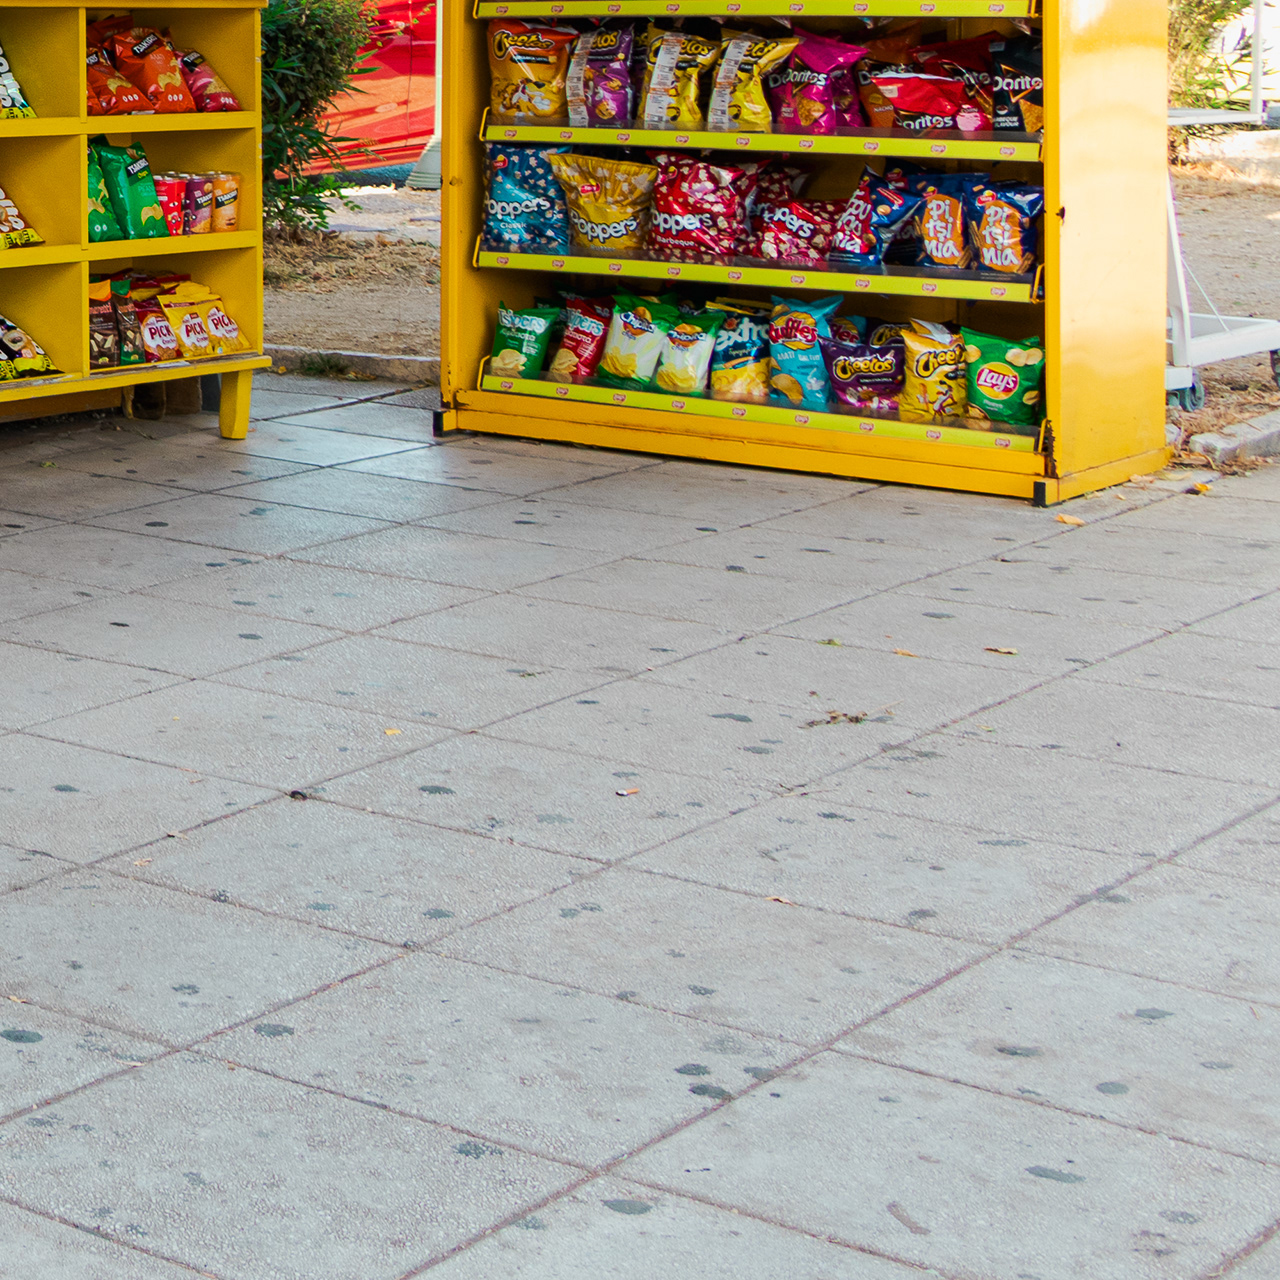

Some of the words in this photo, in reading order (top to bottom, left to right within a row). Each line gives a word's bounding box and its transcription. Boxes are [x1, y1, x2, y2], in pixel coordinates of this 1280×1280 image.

[570, 210, 639, 242] Poppers
[656, 235, 695, 247] Barbeque
[148, 324, 175, 340] PICK
[833, 355, 896, 381] Cheetos
[976, 367, 1019, 391] Lay's
